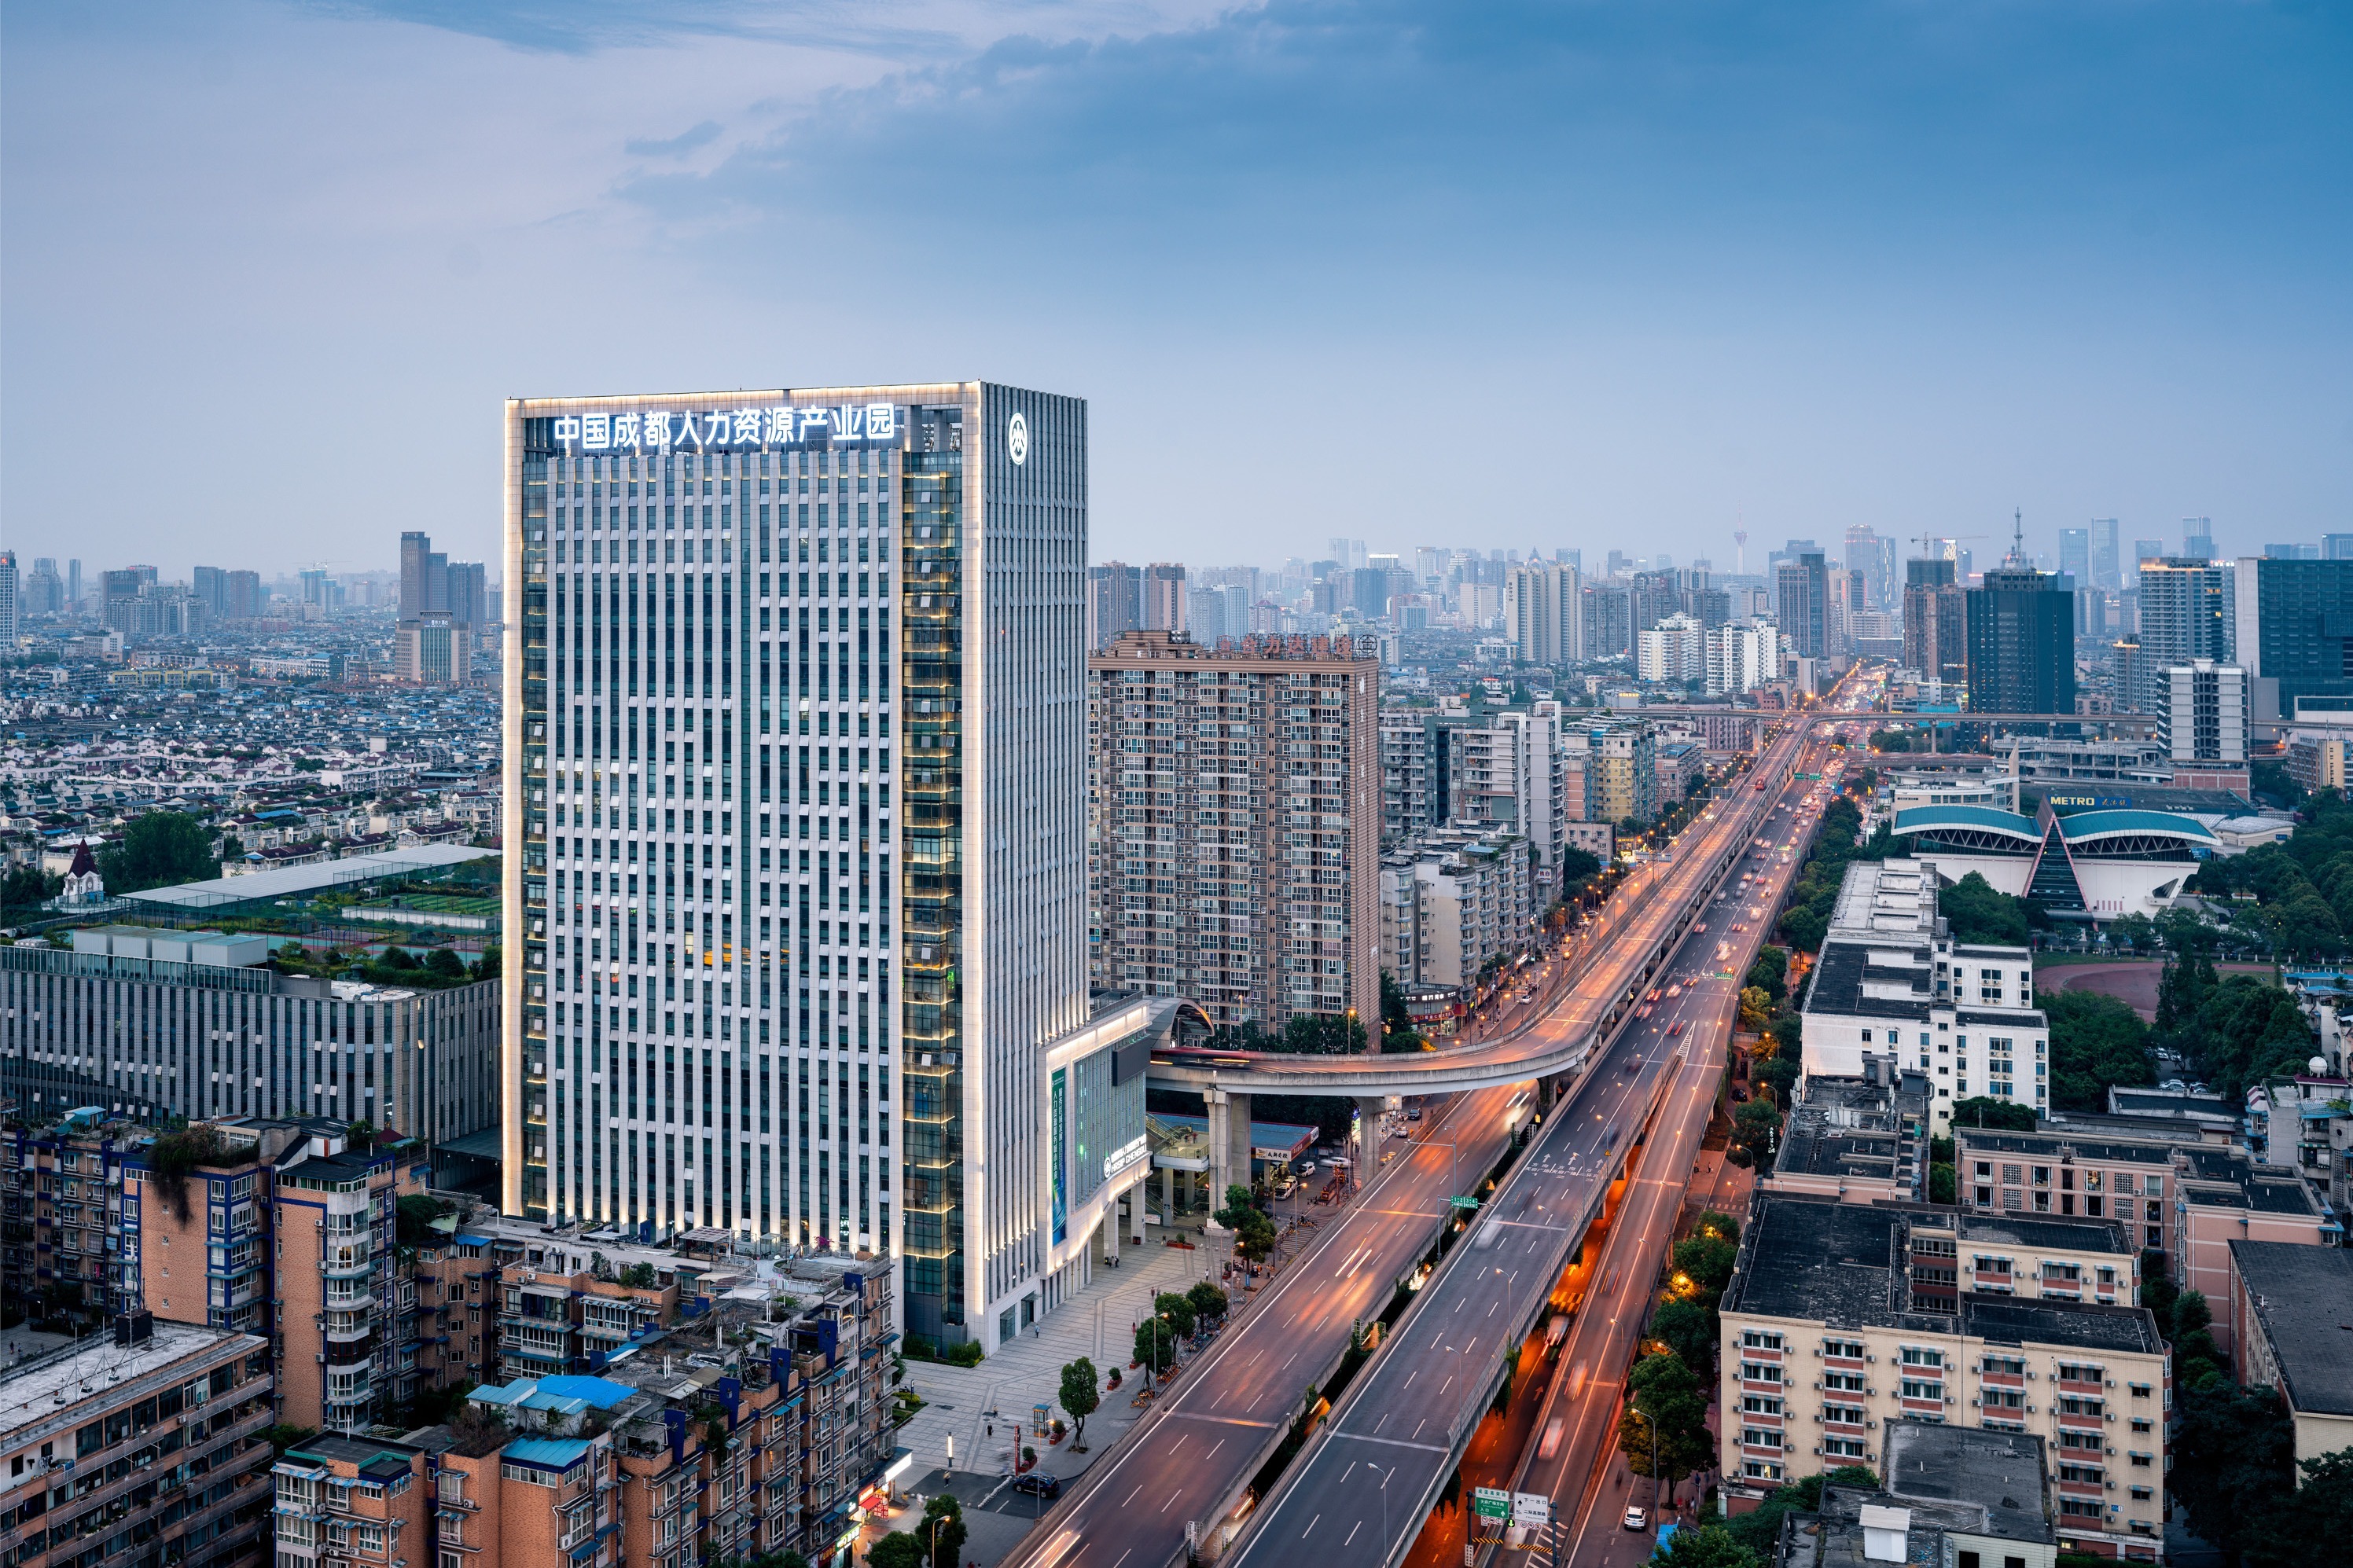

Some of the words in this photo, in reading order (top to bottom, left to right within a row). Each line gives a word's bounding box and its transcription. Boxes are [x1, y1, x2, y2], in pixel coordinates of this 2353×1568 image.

[553, 402, 895, 450] 中国成都人力资源产业园
[2050, 796, 2095, 806] METRO
[1480, 1499, 1505, 1507] 天府广场方向
